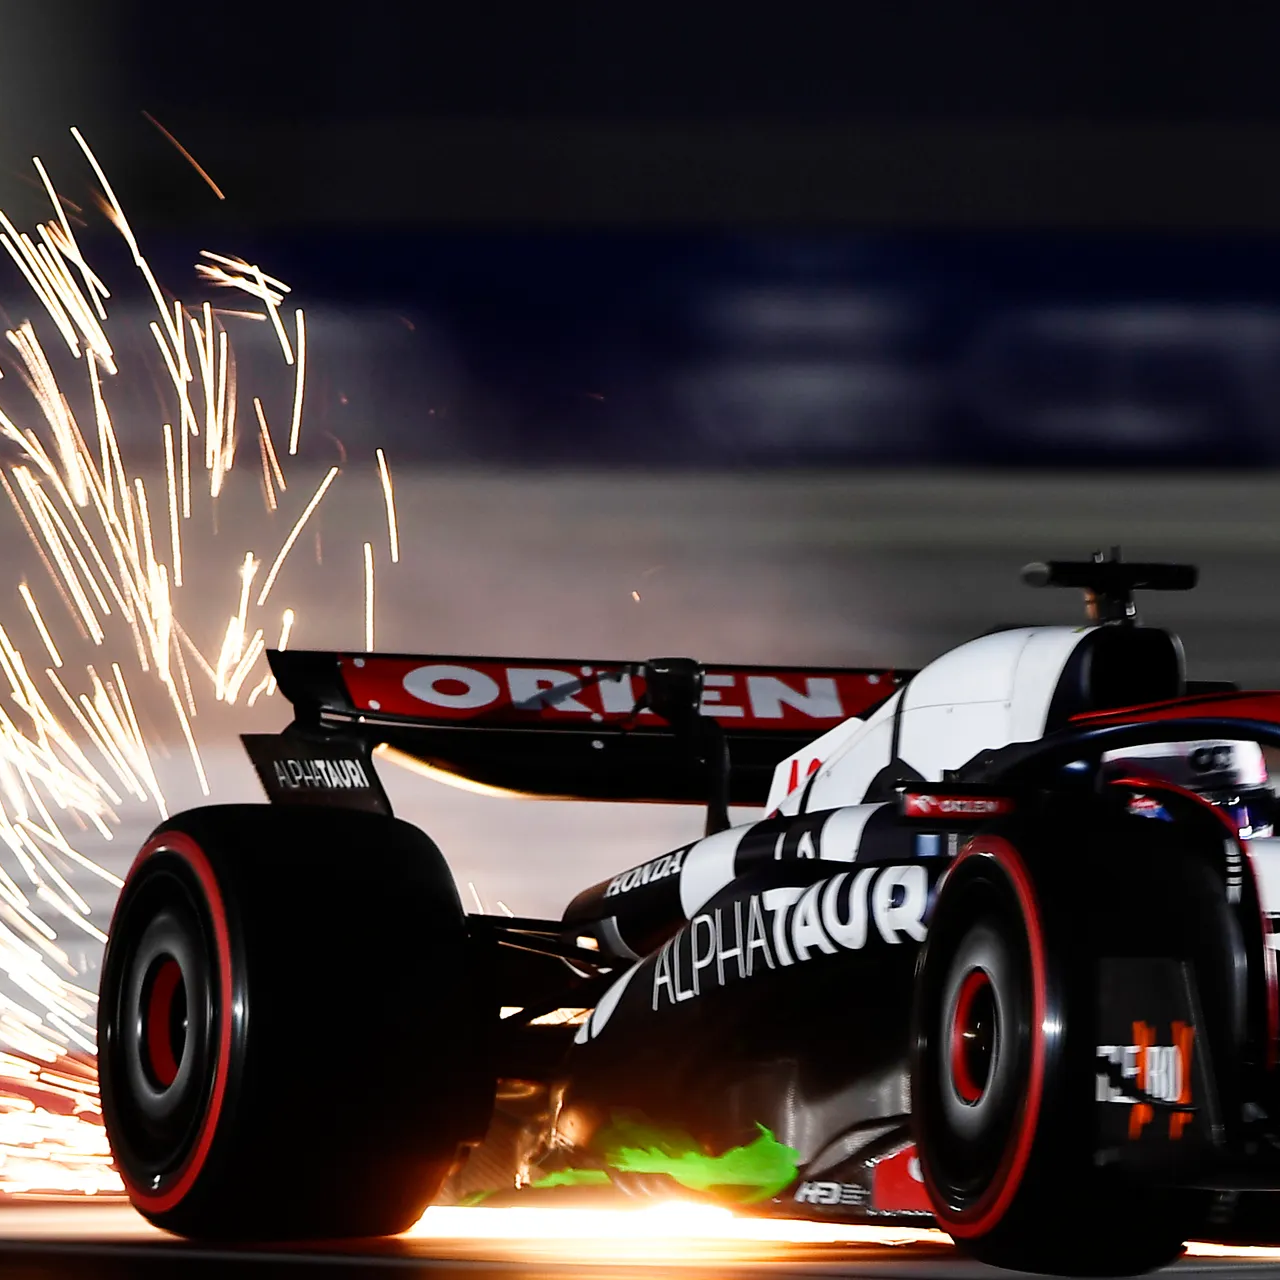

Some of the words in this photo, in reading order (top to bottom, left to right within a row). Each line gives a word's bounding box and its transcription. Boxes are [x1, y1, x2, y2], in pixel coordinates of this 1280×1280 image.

[401, 663, 845, 720] ORLEN
[273, 758, 371, 789] ALPHATAURI
[603, 848, 686, 899] HONDA
[651, 864, 930, 1012] ALPHATAUR
